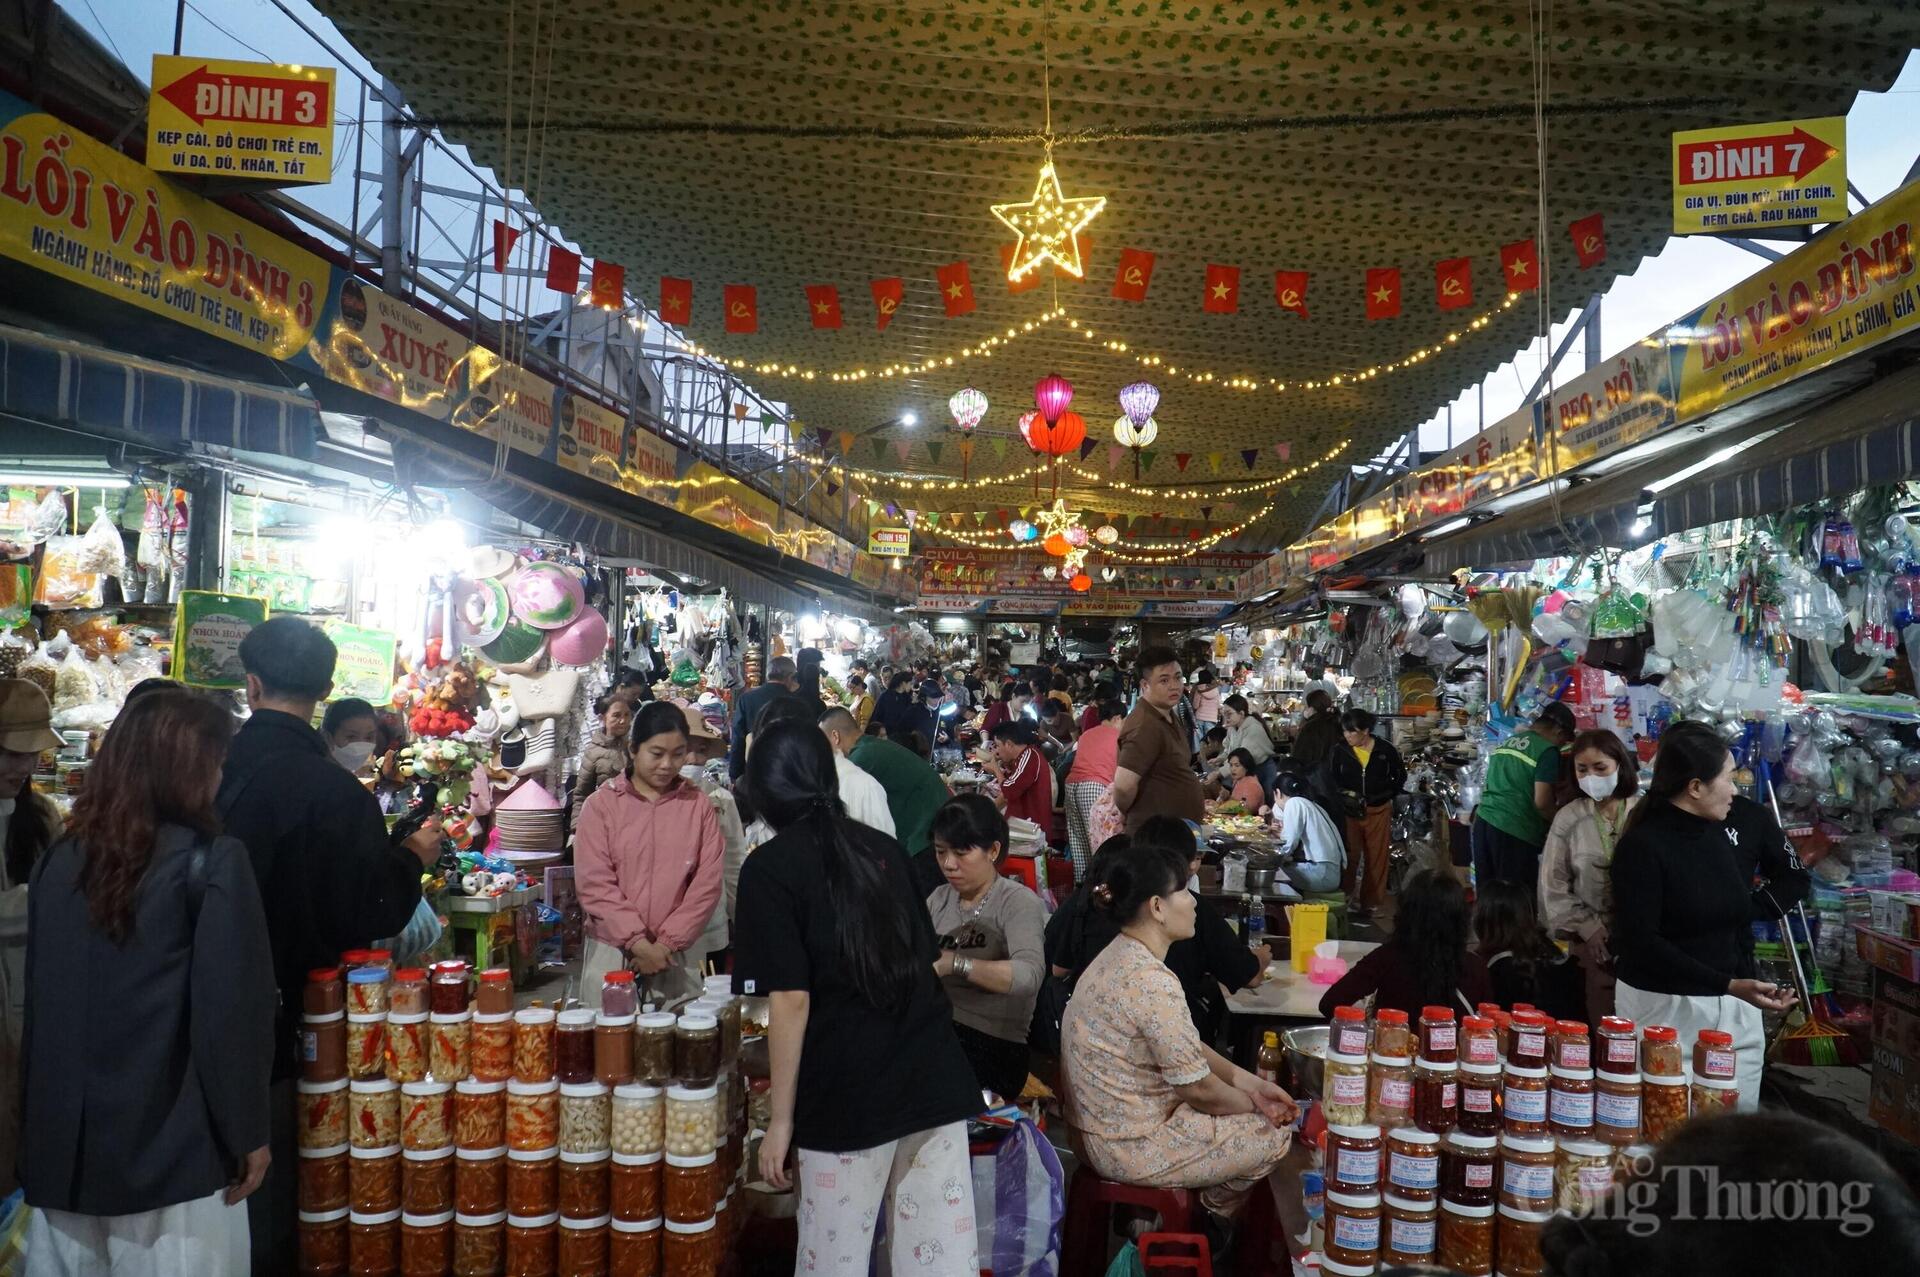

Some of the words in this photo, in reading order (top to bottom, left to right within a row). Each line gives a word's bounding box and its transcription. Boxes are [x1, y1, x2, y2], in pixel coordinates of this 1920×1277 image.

[195, 77, 284, 121] ĐÌNH
[294, 90, 317, 124] 3
[157, 130, 182, 147] KẸP
[215, 131, 235, 149] ĐỒ
[238, 136, 267, 151] CHƠI
[272, 136, 295, 154] TRẺ
[173, 151, 186, 166] VÍ
[284, 157, 306, 175] TẤT
[1691, 143, 1774, 181] ĐÌNH
[1784, 142, 1806, 173] 7
[1685, 196, 1704, 209] GIA
[1778, 189, 1801, 203] THỊT
[1, 133, 90, 230] LỐI
[102, 184, 196, 272] VÀO
[202, 232, 290, 319] ĐÌNH
[295, 280, 314, 328] 3
[1702, 212, 1728, 226] NEM
[1761, 209, 1784, 222] RAU
[1787, 205, 1818, 220] HÀNH
[32, 225, 88, 271] NGÀNH
[92, 250, 136, 290] HÀNG:
[141, 267, 161, 299] ĐỒ
[165, 281, 196, 314] CHƠI
[200, 296, 221, 324] TRẺ
[250, 315, 269, 345] KẸP
[1701, 302, 1742, 371] LỐI
[1745, 280, 1812, 346] VÀO
[1817, 222, 1914, 315] ĐÌNH
[1783, 342, 1803, 368] RAU
[1855, 300, 1893, 337] GHIM,
[1894, 288, 1916, 319] GIA
[877, 531, 894, 542] ĐÌNH
[895, 533, 907, 543] 15A
[926, 550, 976, 561] CIVILA
